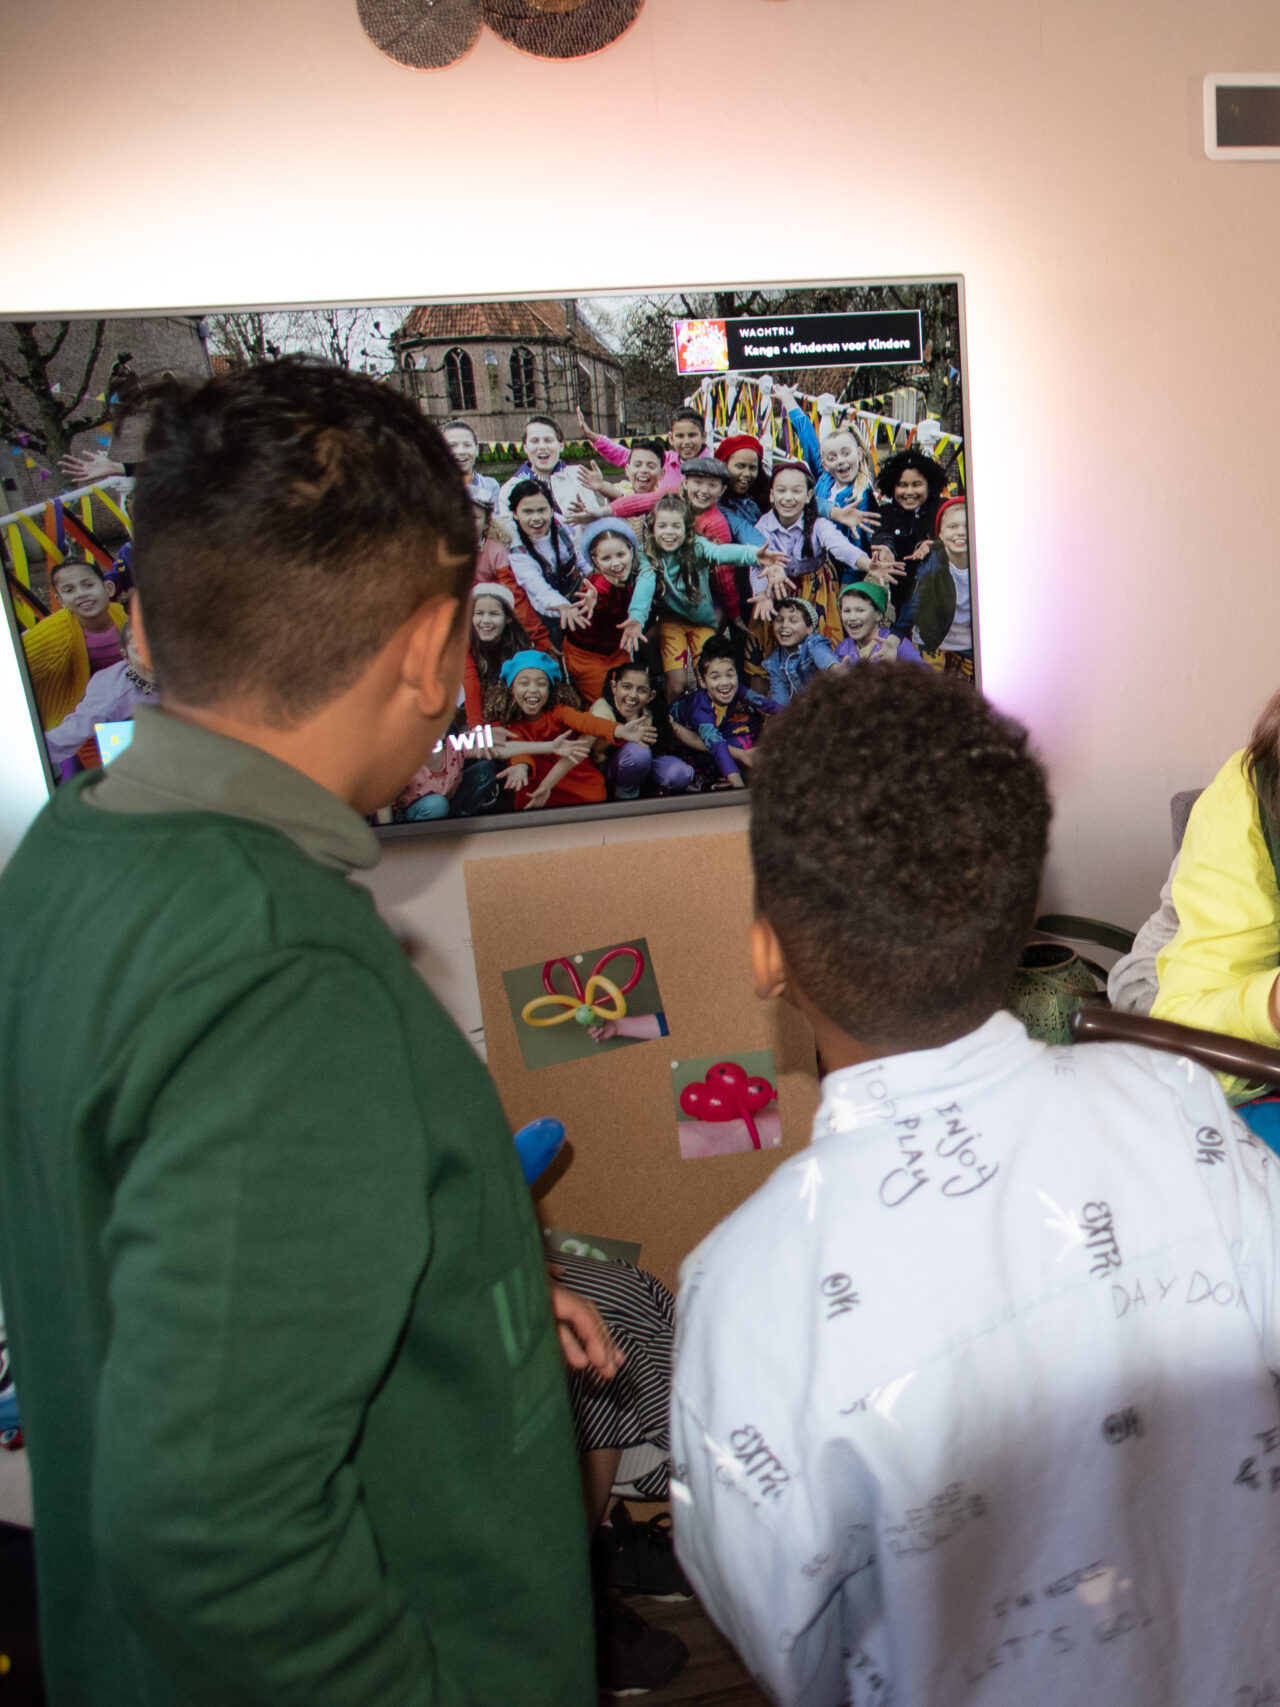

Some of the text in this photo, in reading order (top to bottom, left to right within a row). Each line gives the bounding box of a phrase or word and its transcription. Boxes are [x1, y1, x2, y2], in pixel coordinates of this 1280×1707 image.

[739, 326, 795, 338] WACHTRIJ
[790, 341, 841, 355] Kinderen
[842, 340, 867, 352] voor
[879, 1116, 930, 1207] PLAY
[936, 1101, 1000, 1197] ENJOY
